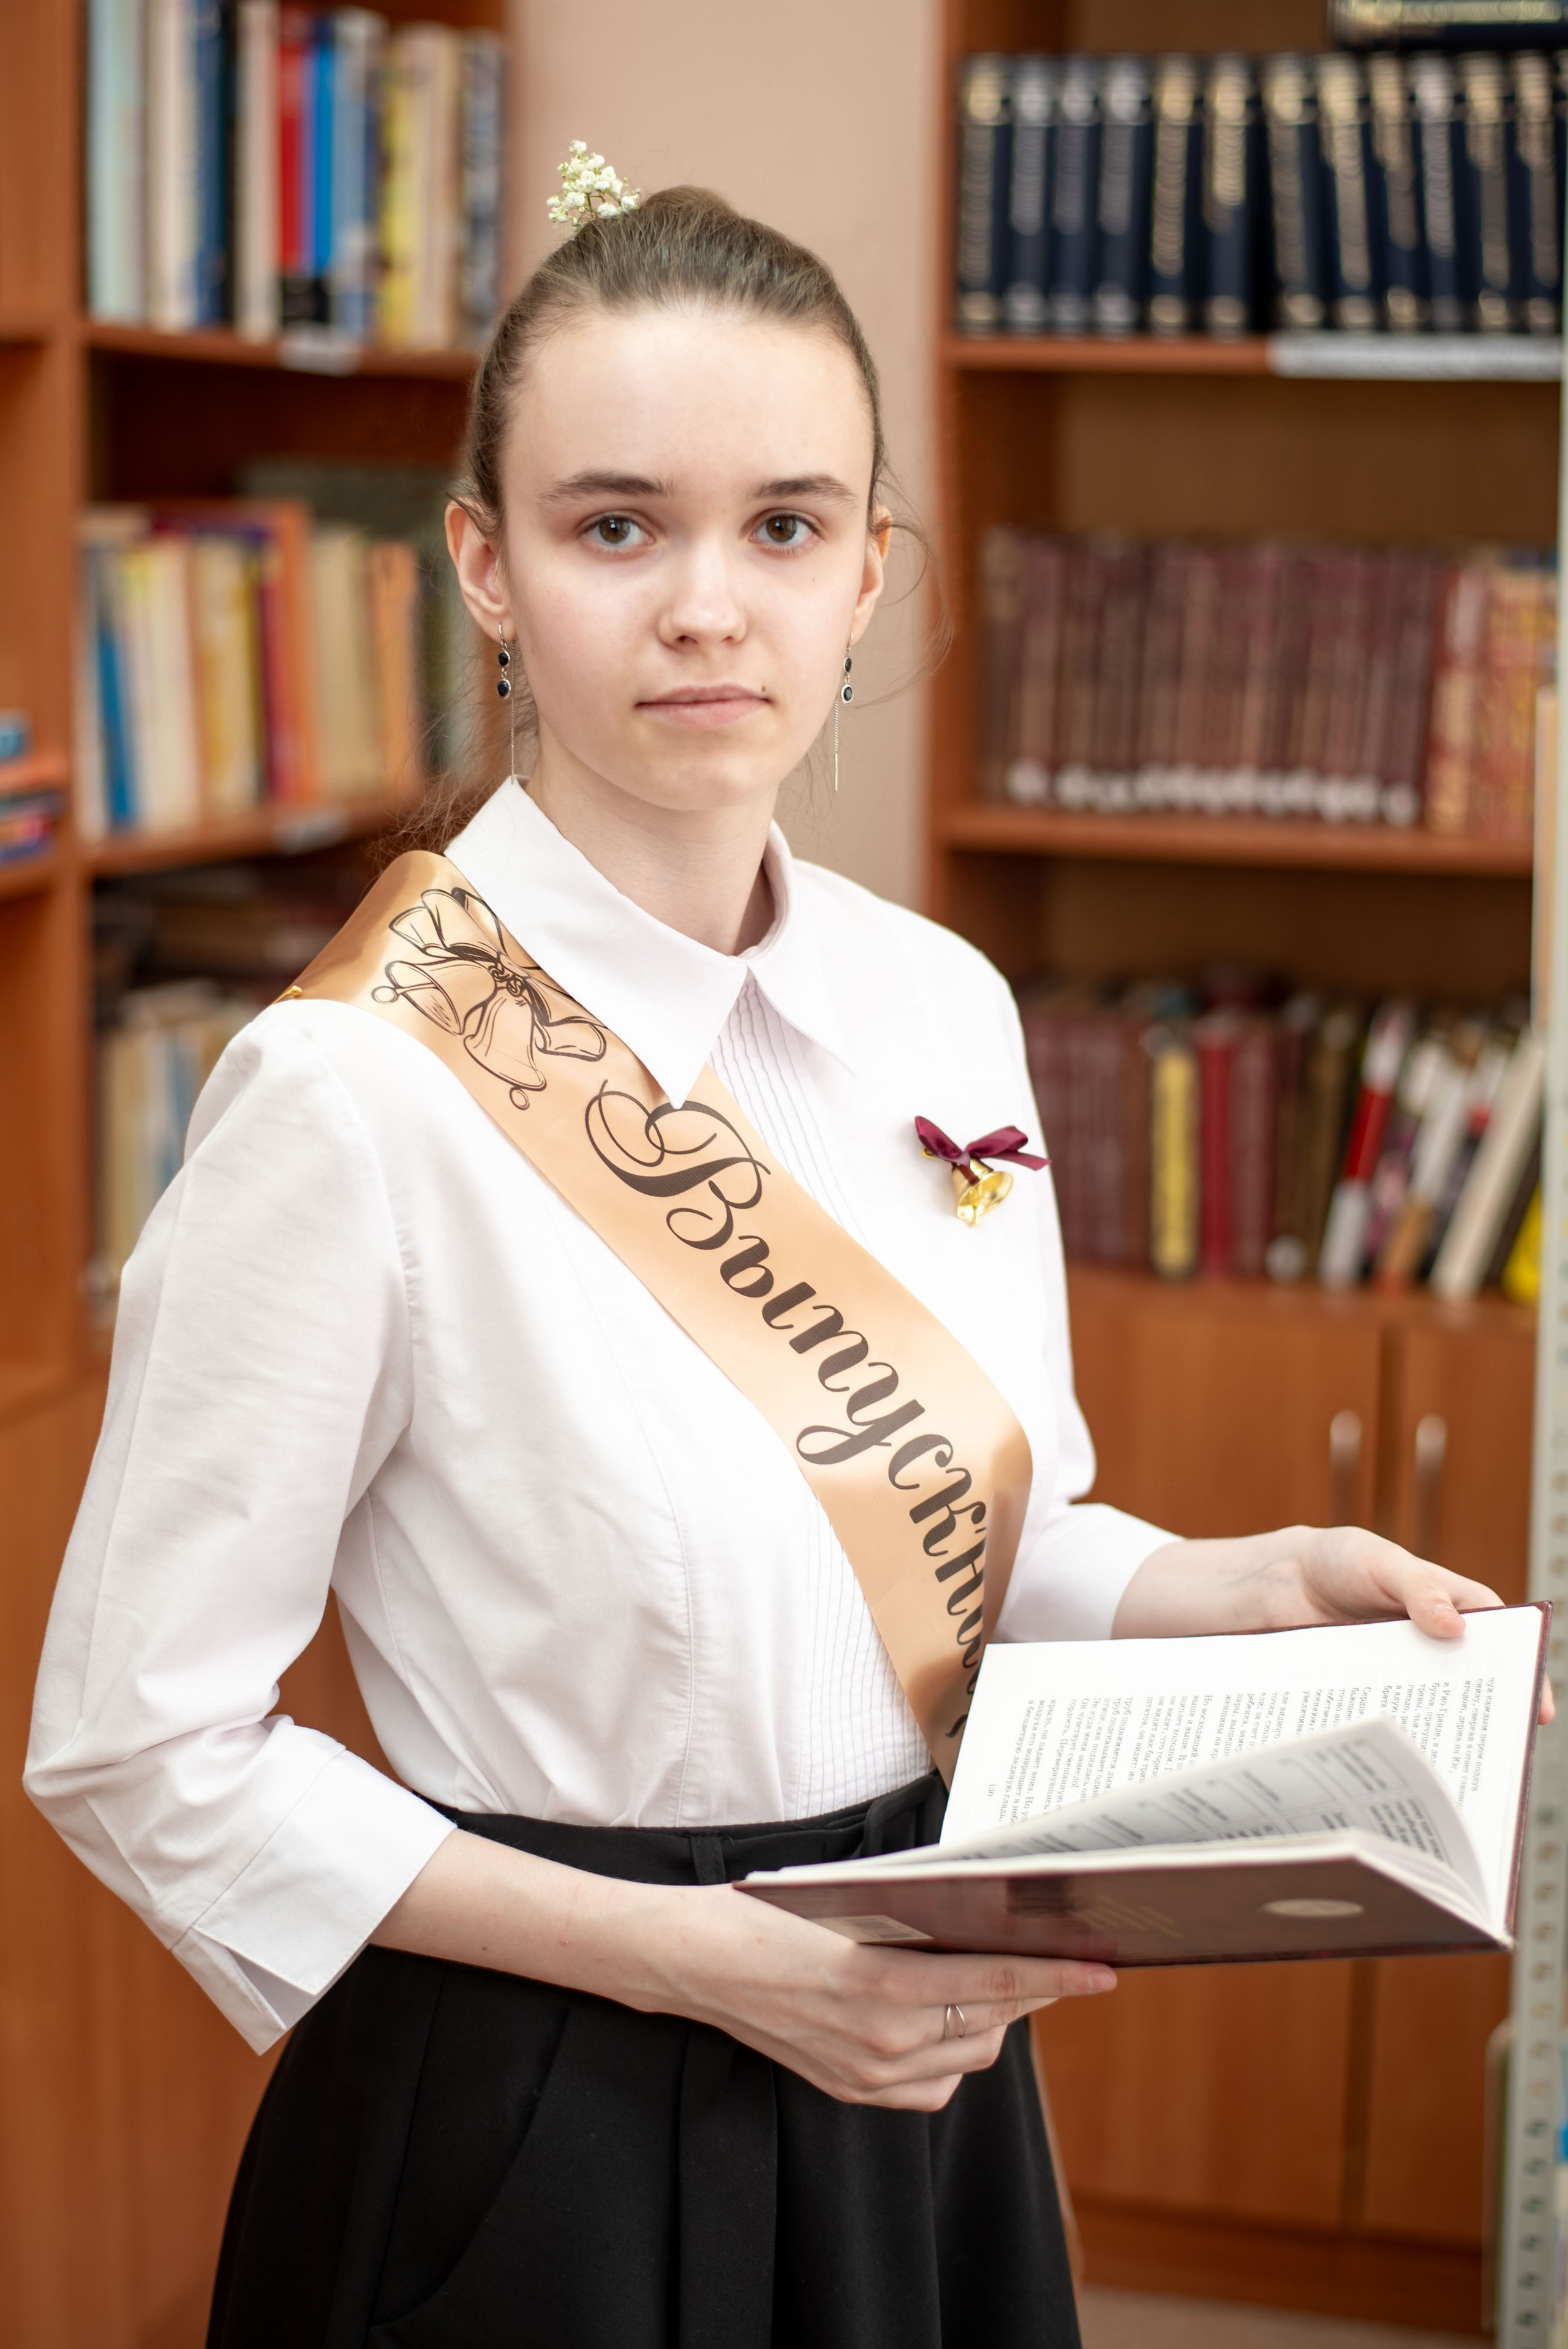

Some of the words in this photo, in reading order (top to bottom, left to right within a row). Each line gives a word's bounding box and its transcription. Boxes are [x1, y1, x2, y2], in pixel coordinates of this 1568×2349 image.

[1484, 1677, 1495, 1692] чуя
[1080, 1698, 1090, 1710] Он
[1091, 1697, 1102, 1708] Эк
[1109, 1697, 1124, 1715] труб
[1121, 1697, 1136, 1715] труб
[1157, 1695, 1165, 1705] он
[1168, 1695, 1177, 1705] он
[1188, 1695, 1199, 1717] выше
[1202, 1694, 1213, 1706] Но
[1280, 1691, 1289, 1705] еле
[1309, 1689, 1322, 1725] осеннюю
[1335, 1688, 1346, 1711] точно
[1379, 1685, 1392, 1708] брата
[1390, 1691, 1401, 1713] алую
[1030, 1699, 1046, 1730] воздуха
[1084, 1710, 1096, 1729] куда
[1150, 1708, 1163, 1731] видит
[1174, 1695, 1188, 1725] щиплет
[1216, 1694, 1232, 1734] женщины
[1254, 1711, 1262, 1719] за
[1321, 1689, 1336, 1729] собственн
[1479, 1695, 1493, 1731] каждым
[1068, 1711, 1085, 1751] чувствует
[1250, 1721, 1260, 1739] счет
[1272, 1706, 1286, 1739] видного
[1412, 1713, 1421, 1728] чьи
[1453, 1715, 1466, 1741] держа
[1464, 1708, 1478, 1741] сверкая
[1028, 1732, 1038, 1746] его
[1040, 1729, 1049, 1739] он
[1080, 1732, 1091, 1751] меня
[1093, 1726, 1103, 1741] как
[1137, 1730, 1145, 1740] он
[1147, 1733, 1156, 1748] как
[1158, 1736, 1167, 1749] что
[1214, 1736, 1223, 1746] на
[1234, 1729, 1247, 1753] замер
[1261, 1720, 1272, 1744] сколь
[1418, 1711, 1433, 1754] прячущи
[1032, 1741, 1046, 1769] падает
[1143, 1750, 1155, 1761] бы
[1453, 1744, 1461, 1754] на
[1474, 1733, 1487, 1759] пером
[1082, 1743, 1099, 1786] поднялась
[1462, 1751, 1471, 1773] ответ
[1003, 1755, 1020, 1792] ледяную
[1055, 1752, 1075, 1803] смешанную
[1127, 1771, 1136, 1781] из
[1469, 1761, 1482, 1792] поддув
[986, 1783, 997, 1797] 130
[1090, 1774, 1103, 1798] один
[1457, 1775, 1468, 1807] глазно
[1023, 1796, 1035, 1808] Но
